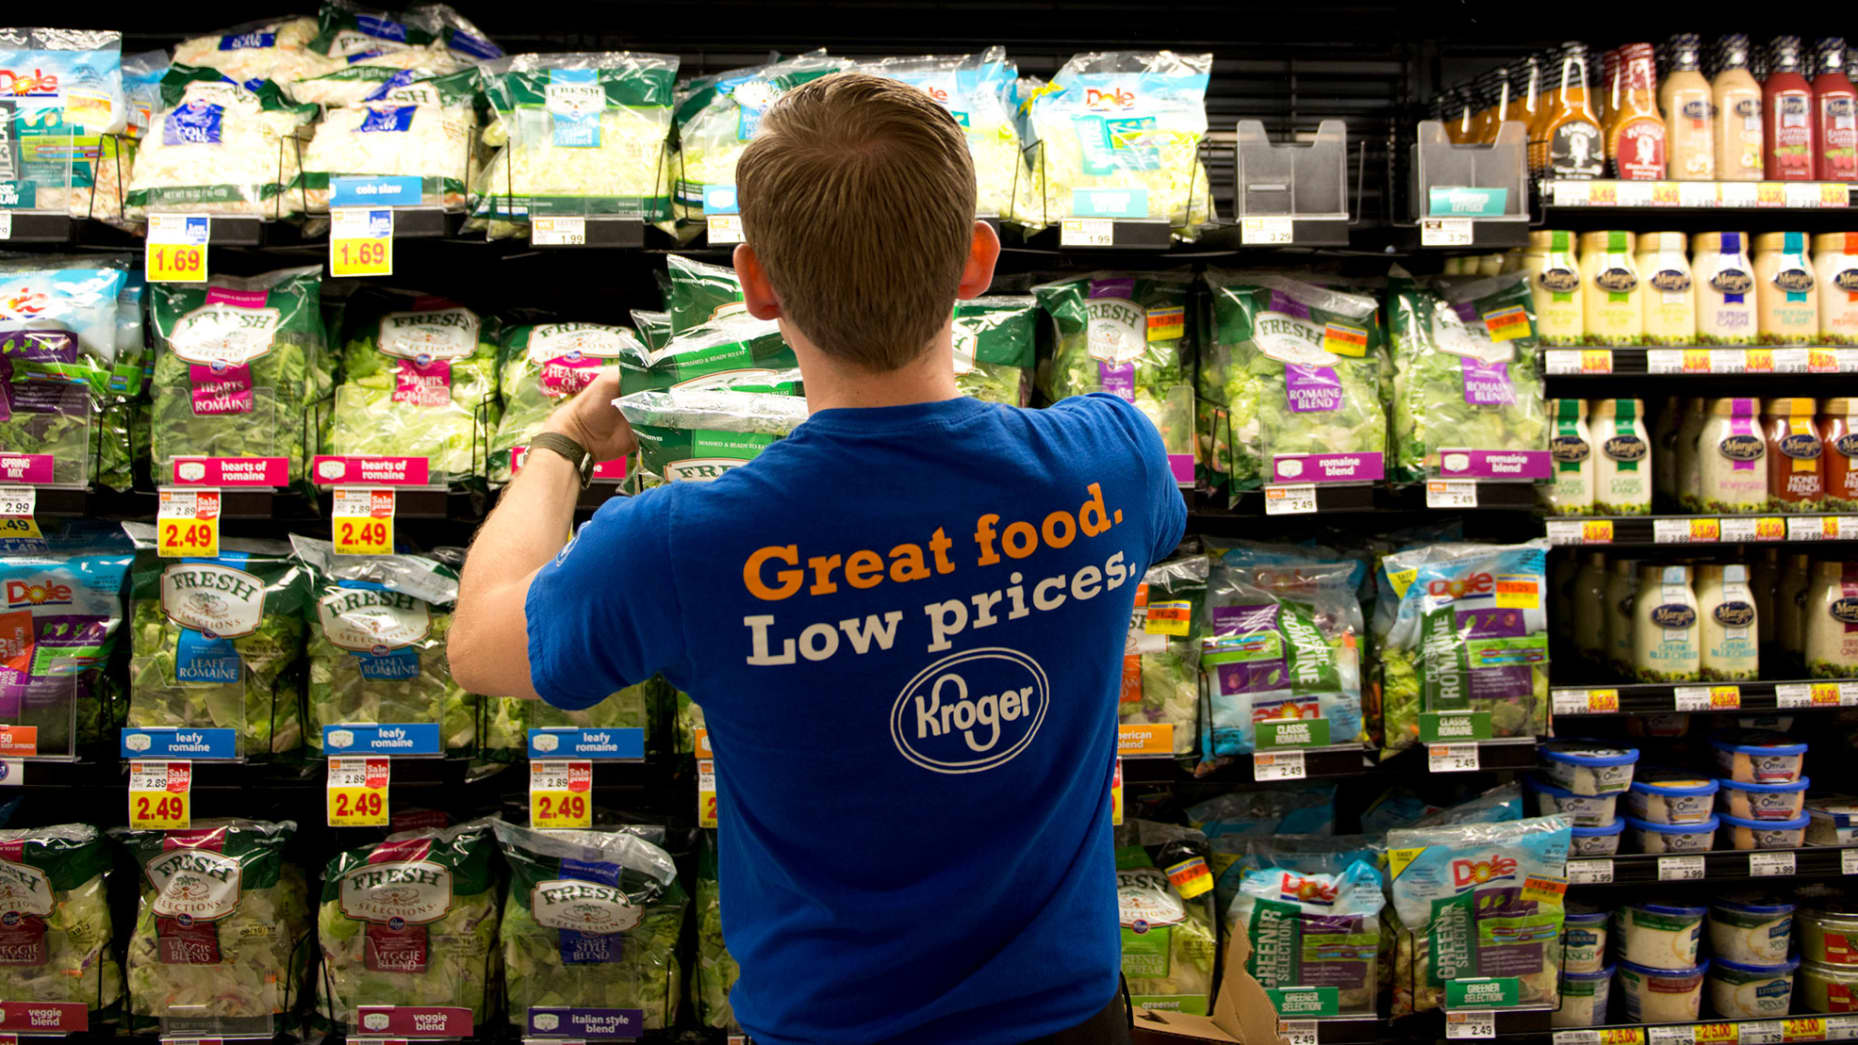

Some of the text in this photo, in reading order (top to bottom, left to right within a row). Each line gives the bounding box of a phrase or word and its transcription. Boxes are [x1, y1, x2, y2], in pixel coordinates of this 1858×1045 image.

[1086, 87, 1135, 108] Dole
[355, 183, 402, 195] cole slaw
[561, 235, 583, 245] 1.99
[341, 243, 385, 265] 1.69
[155, 250, 200, 272] 1.69
[1086, 303, 1140, 330] RESH
[200, 381, 245, 394] HEARTS
[1289, 388, 1341, 402] ROMAINE
[195, 399, 252, 413] ROMAINE
[1297, 397, 1333, 409] BLEND
[1, 458, 31, 469] SPRING
[361, 460, 407, 471] hearts of
[1319, 457, 1360, 467] romaine
[1486, 455, 1528, 465] romaine
[221, 461, 267, 472] hearts of
[1326, 465, 1355, 476] blend
[1492, 463, 1521, 473] blend
[7, 468, 24, 478] MIX
[222, 472, 265, 481] romaine
[362, 471, 405, 480] romaine
[1789, 475, 1819, 485] HONEY
[176, 496, 218, 516] 2.89 Sale
[350, 495, 393, 514] 2.89 Sale
[1292, 500, 1314, 511] 2.49
[1453, 495, 1473, 505] 2.49
[5, 502, 30, 513] 2.99
[166, 524, 212, 548] 2.49
[341, 522, 387, 546] 2.49
[743, 482, 1124, 601] Great food.
[171, 571, 258, 603] FRESH
[1428, 572, 1494, 597] Dole
[7, 579, 72, 605] Dole
[326, 589, 416, 618] FRESH
[743, 550, 1137, 666] Low prices.
[1281, 609, 1320, 684] ROMAINE
[1301, 624, 1329, 667] CLASSIC
[1434, 613, 1461, 699] ROMAINE
[191, 658, 225, 669] LEAFY
[180, 667, 238, 680] ROMAINE
[915, 673, 1034, 752] Kroger
[1439, 718, 1471, 727] CLASSIC
[379, 728, 406, 740] leafy
[1276, 724, 1309, 734] CLASSIC
[1438, 726, 1473, 736] ROMAINE
[176, 732, 203, 744] leafy
[371, 738, 413, 749] romaine
[583, 732, 610, 744] leafy
[1275, 733, 1311, 744] ROMAINE
[168, 743, 210, 753] romaine
[576, 742, 618, 752] romaine
[1455, 759, 1476, 769] 2.49
[345, 765, 388, 784] 2.89 Sale
[547, 768, 590, 787] 2.89 Sale
[1280, 766, 1302, 777] 2.49
[146, 769, 188, 788] 2.89 Sale
[137, 797, 183, 820] 2.49
[336, 793, 382, 817] 2.49
[539, 796, 585, 819] 2.49
[153, 854, 234, 883] FRESH
[1452, 854, 1518, 888] Dole
[1684, 870, 1703, 879] 3.99
[1775, 866, 1794, 875] 3.99
[352, 866, 441, 891] FRESH
[1592, 873, 1612, 882] 3.99
[540, 884, 632, 908] FRESH
[357, 902, 435, 918] SELECTIONS
[1455, 905, 1469, 968] SELECTION
[169, 941, 211, 954] VEGGIE
[576, 942, 609, 953] STYLE
[1277, 919, 1292, 981] SELECTION
[171, 951, 211, 962] BLEND
[375, 950, 421, 962] VEGGIE
[573, 951, 610, 961] BLEND
[377, 960, 417, 971] BLEND
[1467, 983, 1500, 993] GREENER
[1285, 993, 1318, 1002] GREENER
[1142, 1001, 1180, 1010] greener
[28, 1007, 62, 1018] veggie
[413, 1012, 448, 1024] veggie
[31, 1016, 60, 1027] blend
[572, 1014, 629, 1026] italian style
[416, 1021, 446, 1032] blend
[586, 1024, 615, 1034] blend
[1471, 1025, 1492, 1035] 2.49
[1701, 1024, 1731, 1039] 2/5.00
[1762, 1019, 1820, 1043] 3.29 2/5.00
[1294, 1035, 1315, 1045] 2.49
[1608, 1029, 1637, 1043] 2/5.00
